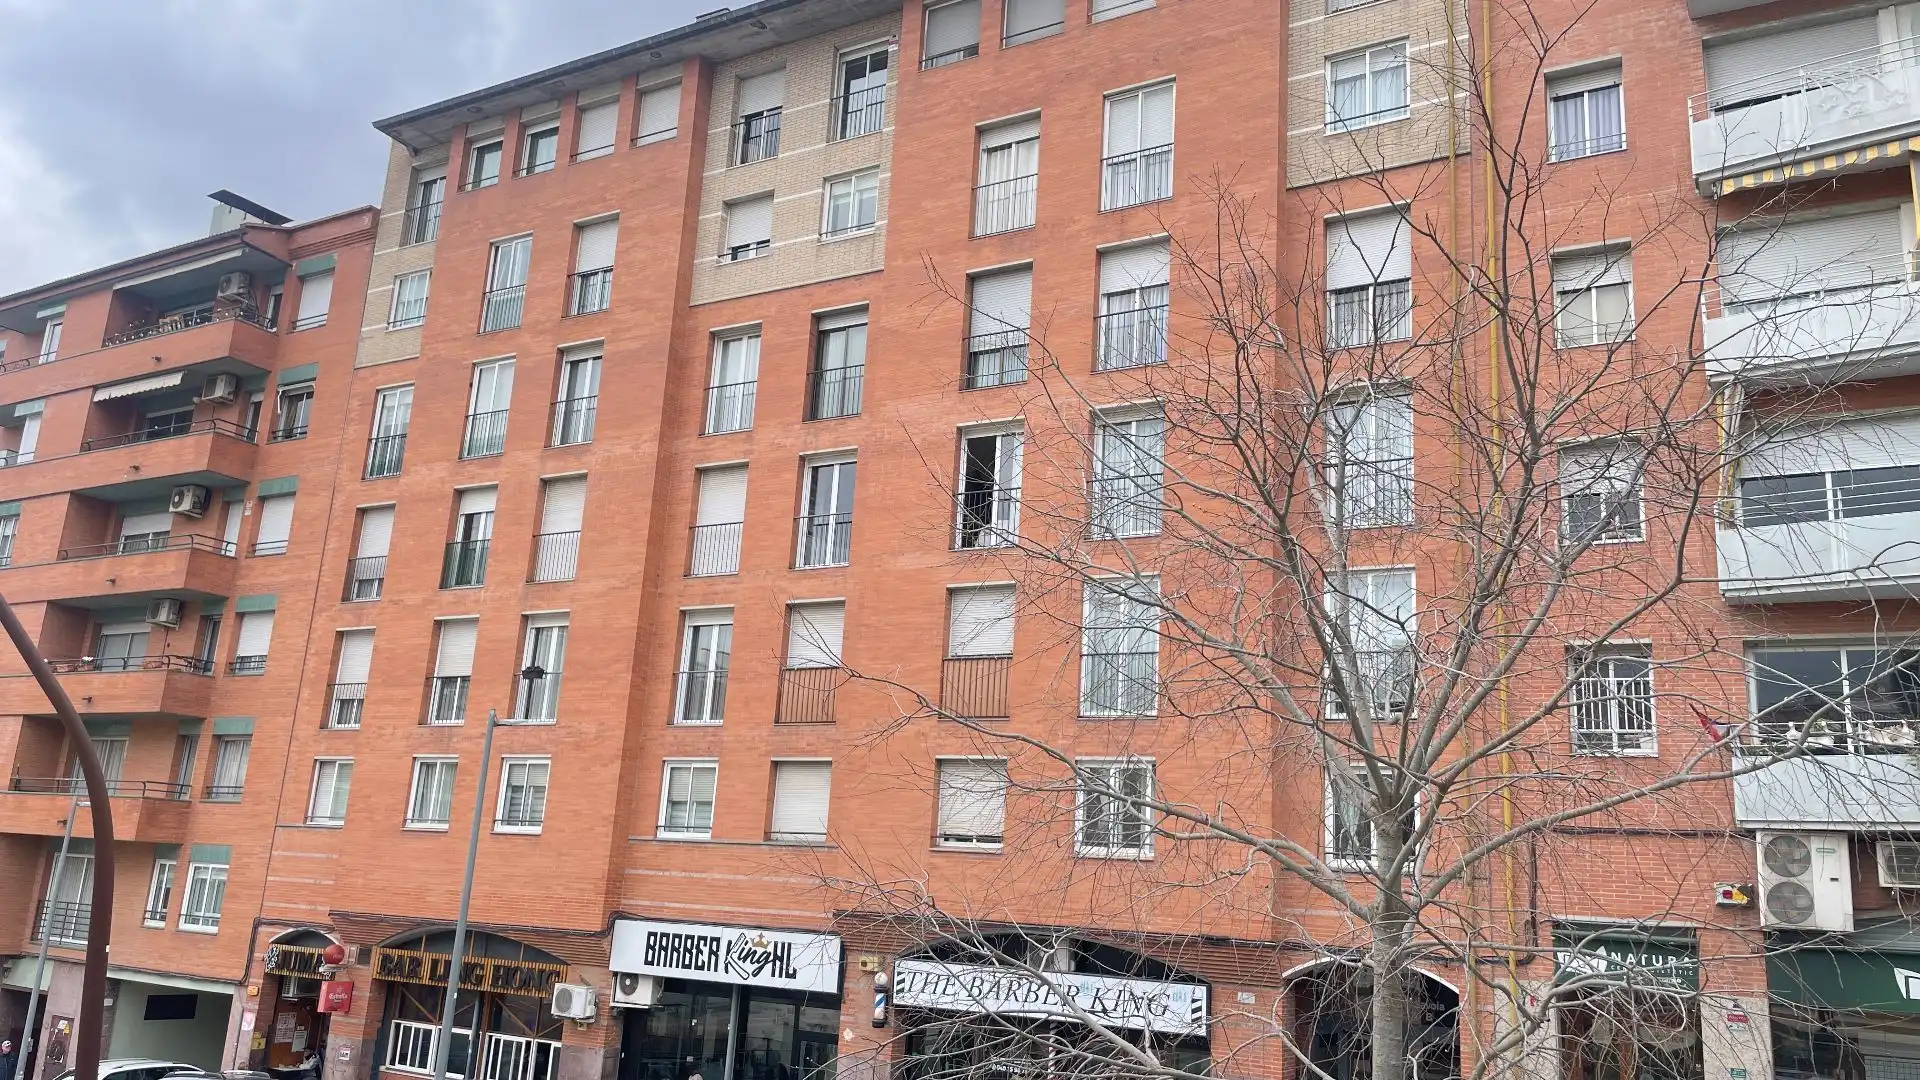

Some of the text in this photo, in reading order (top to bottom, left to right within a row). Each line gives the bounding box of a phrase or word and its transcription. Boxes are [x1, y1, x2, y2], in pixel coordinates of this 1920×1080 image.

[379, 952, 423, 978] BAR
[490, 962, 560, 993] HONG
[643, 930, 721, 973] BARBER
[905, 970, 1171, 1018] THE BARBER KING
